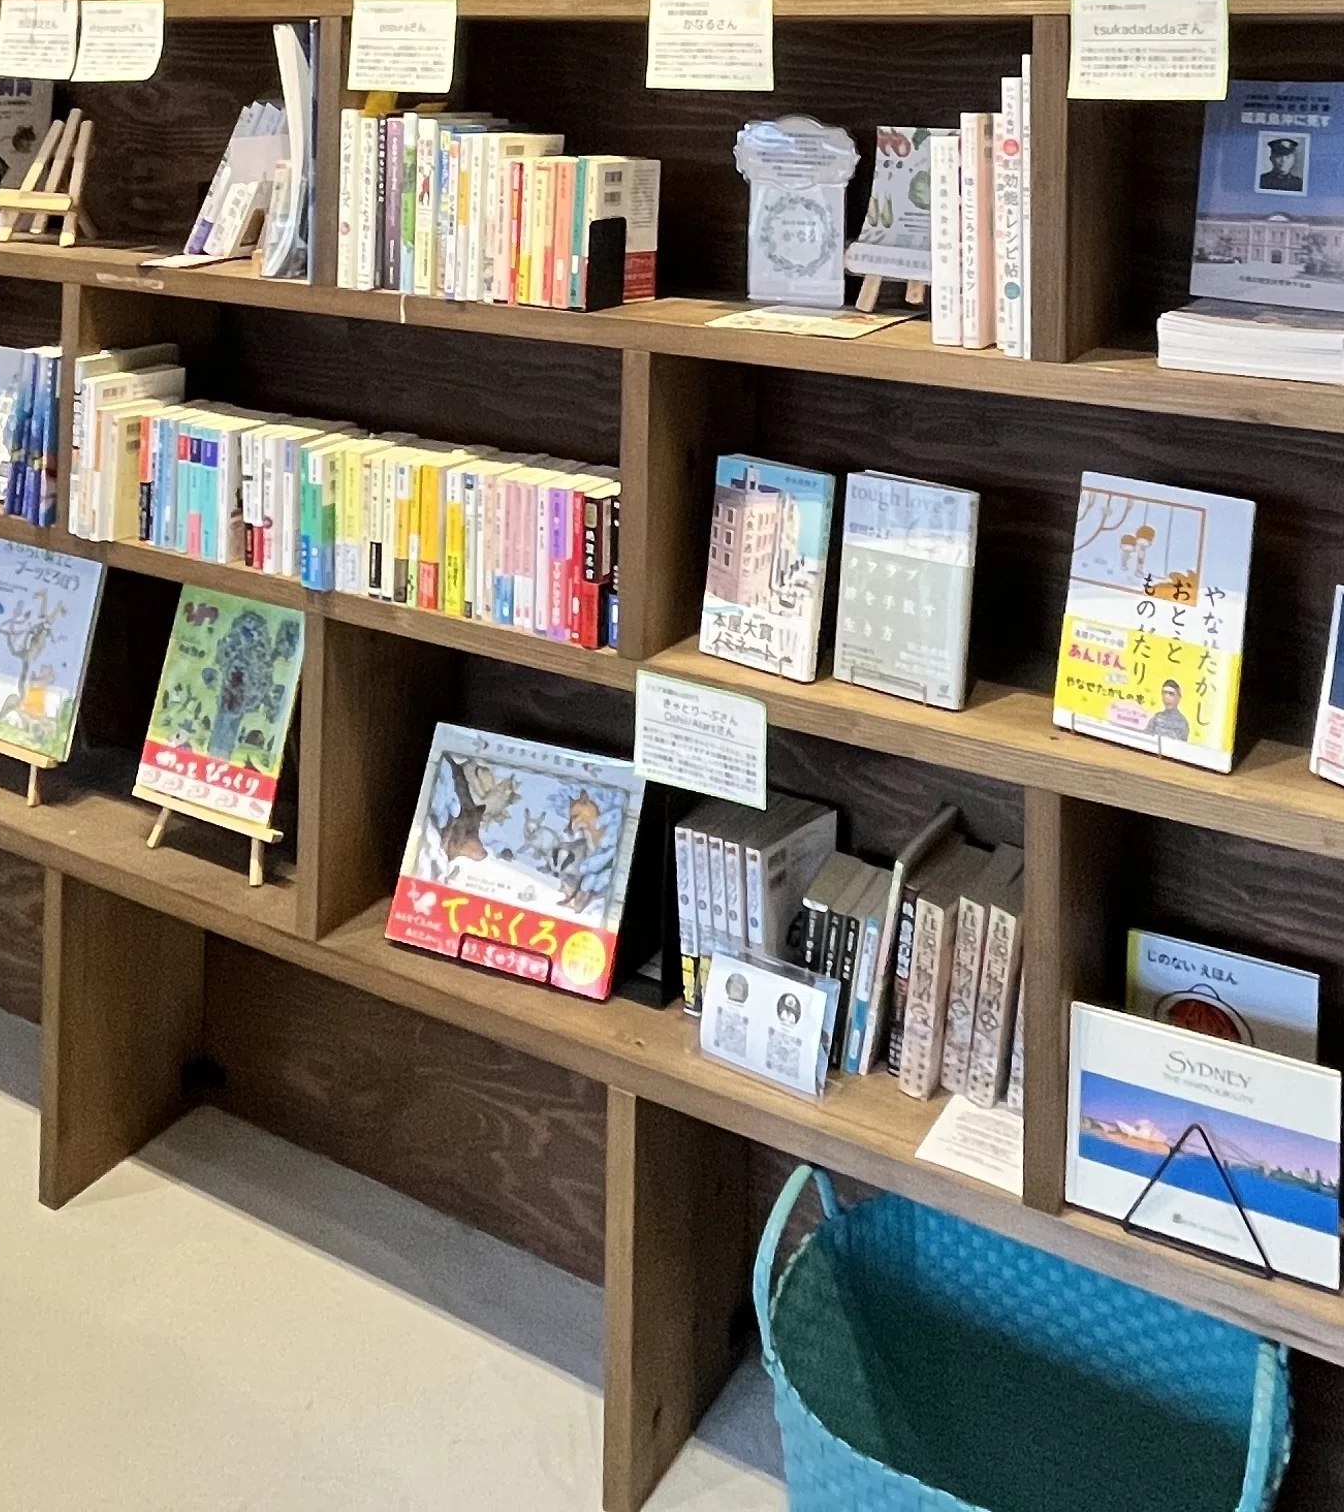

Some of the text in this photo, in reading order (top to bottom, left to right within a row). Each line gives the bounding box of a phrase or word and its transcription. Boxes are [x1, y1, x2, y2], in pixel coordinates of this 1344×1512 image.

[1093, 23, 1205, 36] tsukadadadaさん
[850, 483, 945, 514] tough love
[712, 612, 775, 643] 本屋大賞
[441, 896, 559, 956] てぶくろ
[1147, 949, 1196, 973] じのない
[1165, 1050, 1253, 1089] SYDNEY
